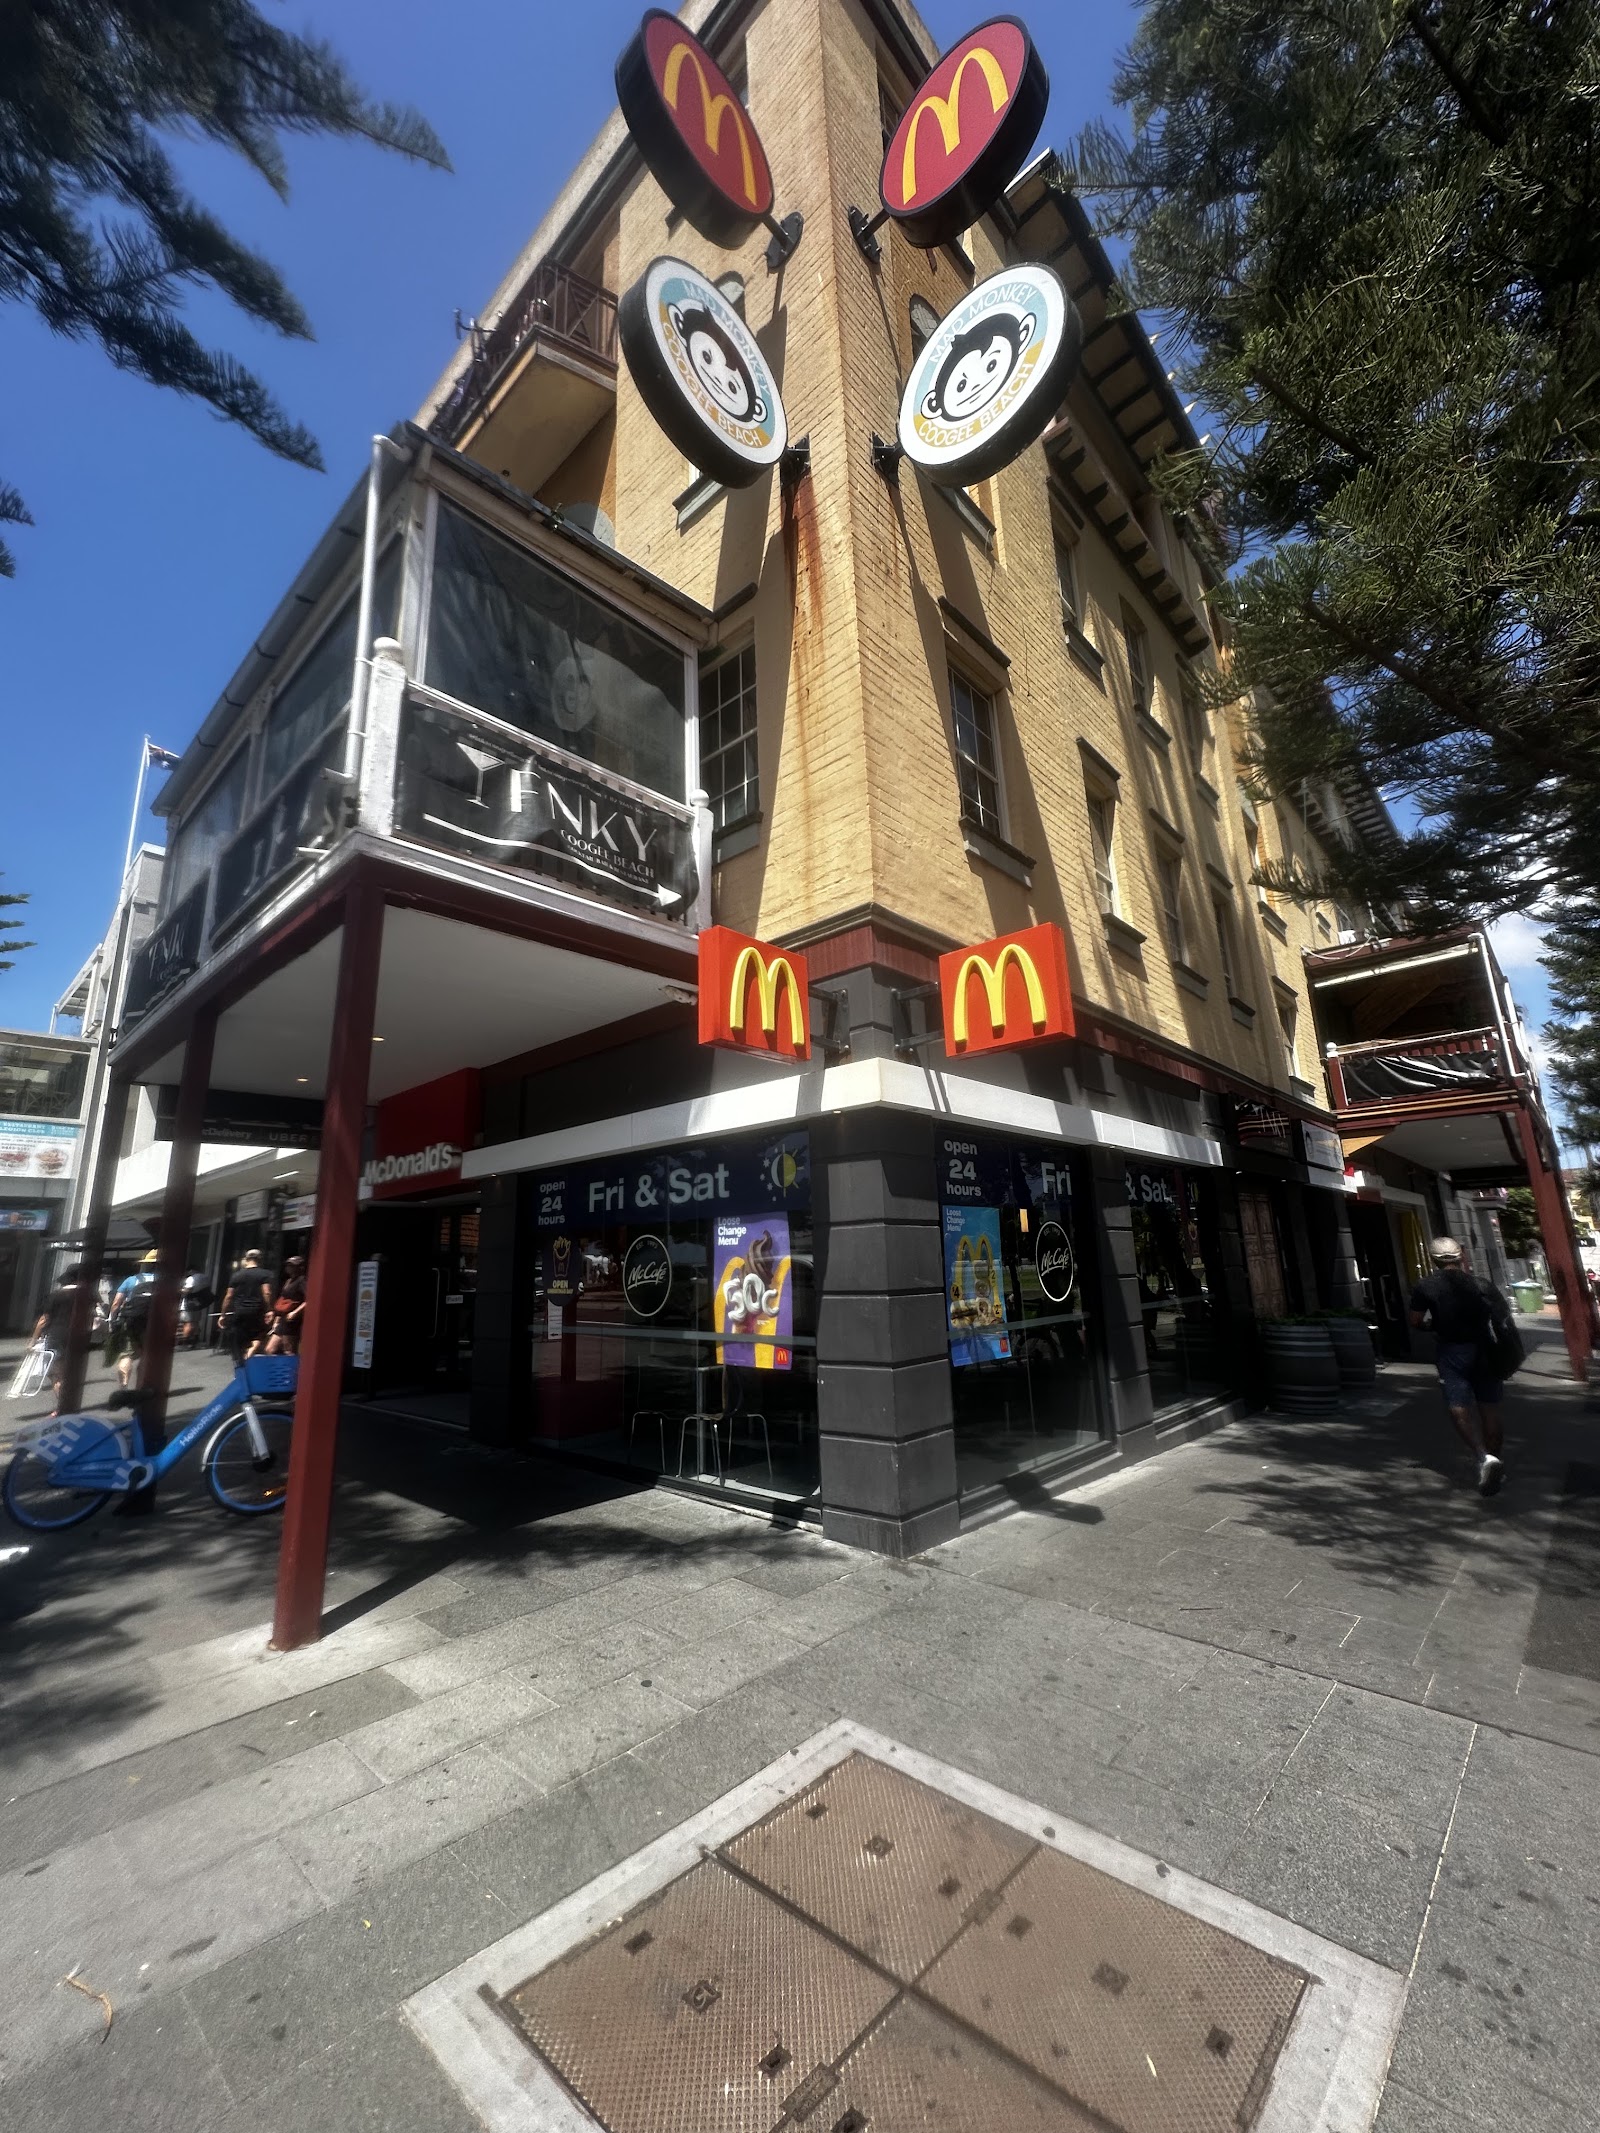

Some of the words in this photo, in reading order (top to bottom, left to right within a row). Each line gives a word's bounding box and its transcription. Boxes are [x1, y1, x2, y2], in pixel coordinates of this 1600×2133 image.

[929, 318, 965, 364] MAD
[969, 283, 1037, 318] MONKEY
[682, 279, 716, 310] MAD
[719, 309, 771, 395] MONKEY
[662, 321, 717, 413] COOGEE
[717, 412, 763, 447] BEACH
[918, 420, 976, 446] COOGEE
[980, 363, 1035, 428] BEACH
[560, 829, 609, 860] COOGEE
[613, 855, 655, 880] BEACH
[944, 1140, 978, 1155] open
[363, 1143, 454, 1186] McDonald's
[949, 1159, 977, 1180] 24
[539, 1180, 566, 1194] open
[589, 1178, 625, 1212] Fri
[635, 1174, 658, 1208] &
[668, 1164, 730, 1204] Sat
[946, 1181, 981, 1197] hours
[1041, 1162, 1072, 1195] Fri
[1140, 1174, 1168, 1203] Sat
[541, 1196, 563, 1213] 24
[946, 1208, 961, 1217] Loose
[538, 1214, 566, 1226] hours
[718, 1217, 741, 1226] Loose
[946, 1216, 965, 1225] Change
[717, 1226, 747, 1239] Change
[717, 1237, 739, 1246] Menu
[552, 1280, 569, 1289] OPEN
[723, 1273, 780, 1323] 50c
[179, 1403, 224, 1447] HelloRide
